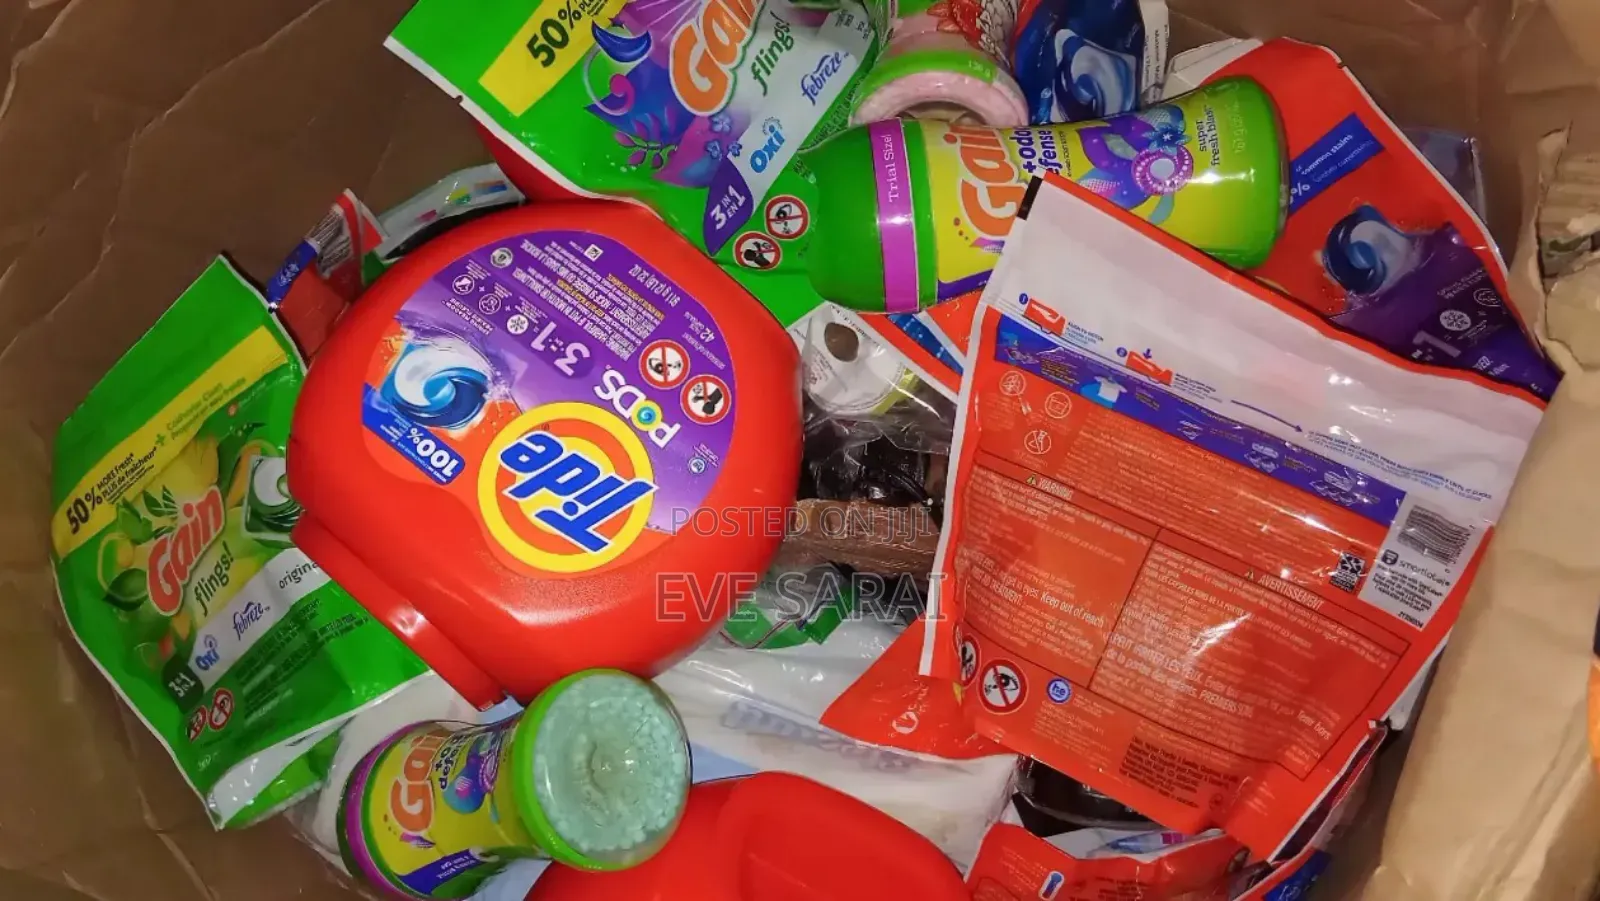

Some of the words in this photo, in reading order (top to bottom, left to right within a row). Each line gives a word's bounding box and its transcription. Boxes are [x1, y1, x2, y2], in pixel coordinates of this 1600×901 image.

[669, 0, 760, 116] Gai
[751, 10, 794, 96] flings!
[800, 51, 844, 105] febreze
[1034, 128, 1062, 176] efense
[1195, 119, 1209, 151] super
[1207, 132, 1220, 165] fresh
[1328, 132, 1355, 154] stains
[728, 185, 746, 207] 1
[889, 166, 901, 203] Trial
[942, 121, 1018, 238] Gai
[710, 204, 728, 231] 3
[531, 321, 560, 350] 1
[698, 326, 717, 345] 42
[558, 342, 591, 377] 3
[594, 363, 681, 449] PODS
[410, 426, 460, 477] 100%
[94, 468, 117, 490] MORE
[501, 431, 656, 551] Tide
[1036, 478, 1074, 501] WARNING
[66, 488, 103, 535] 50%
[147, 496, 223, 614] Gain
[193, 540, 234, 617] flings!
[1255, 572, 1326, 612] AVERTISSEMENT
[232, 602, 265, 641] febreze
[1038, 590, 1060, 609] Keep
[1058, 599, 1074, 614] out
[1080, 609, 1106, 629] reach
[1051, 682, 1067, 696] he
